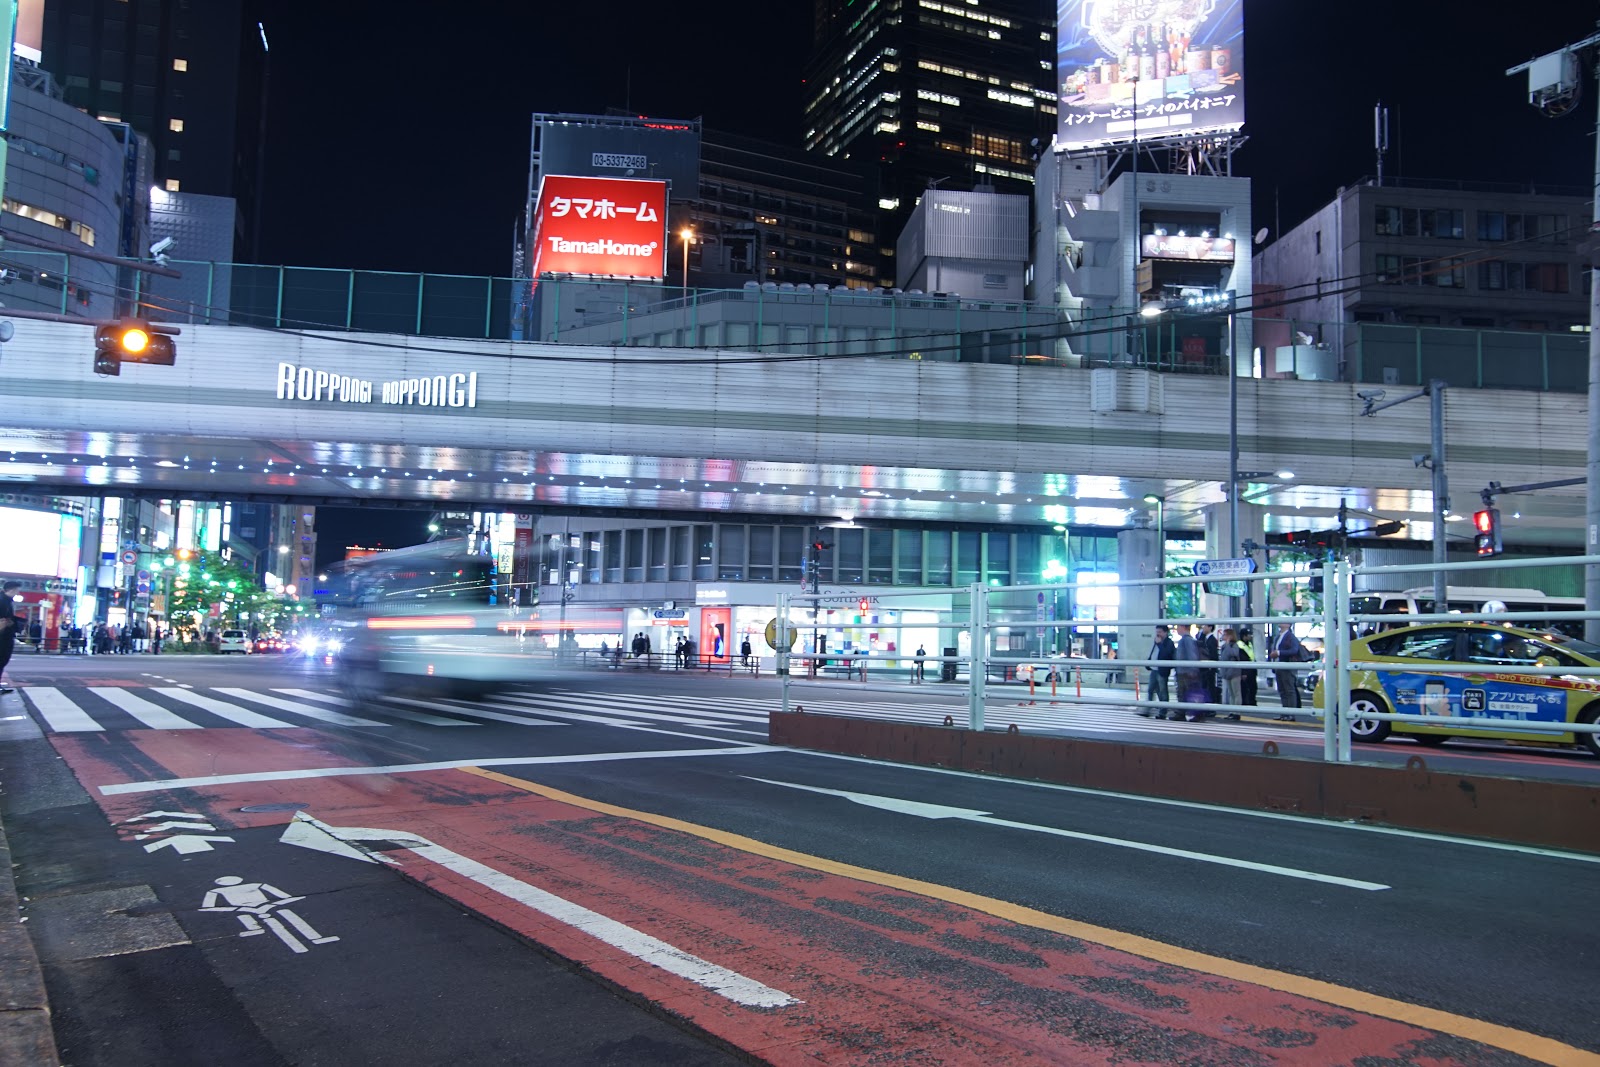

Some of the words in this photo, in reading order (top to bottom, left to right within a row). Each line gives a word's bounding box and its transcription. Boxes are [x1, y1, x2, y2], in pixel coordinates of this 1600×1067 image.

[593, 154, 646, 168] 03-5337-2468
[549, 196, 658, 222] タマホーム
[276, 362, 373, 404] ROPPONGI
[382, 371, 478, 408] ROPPONGI
[1495, 673, 1517, 682] TOYO
[1520, 675, 1547, 685] KOTSU
